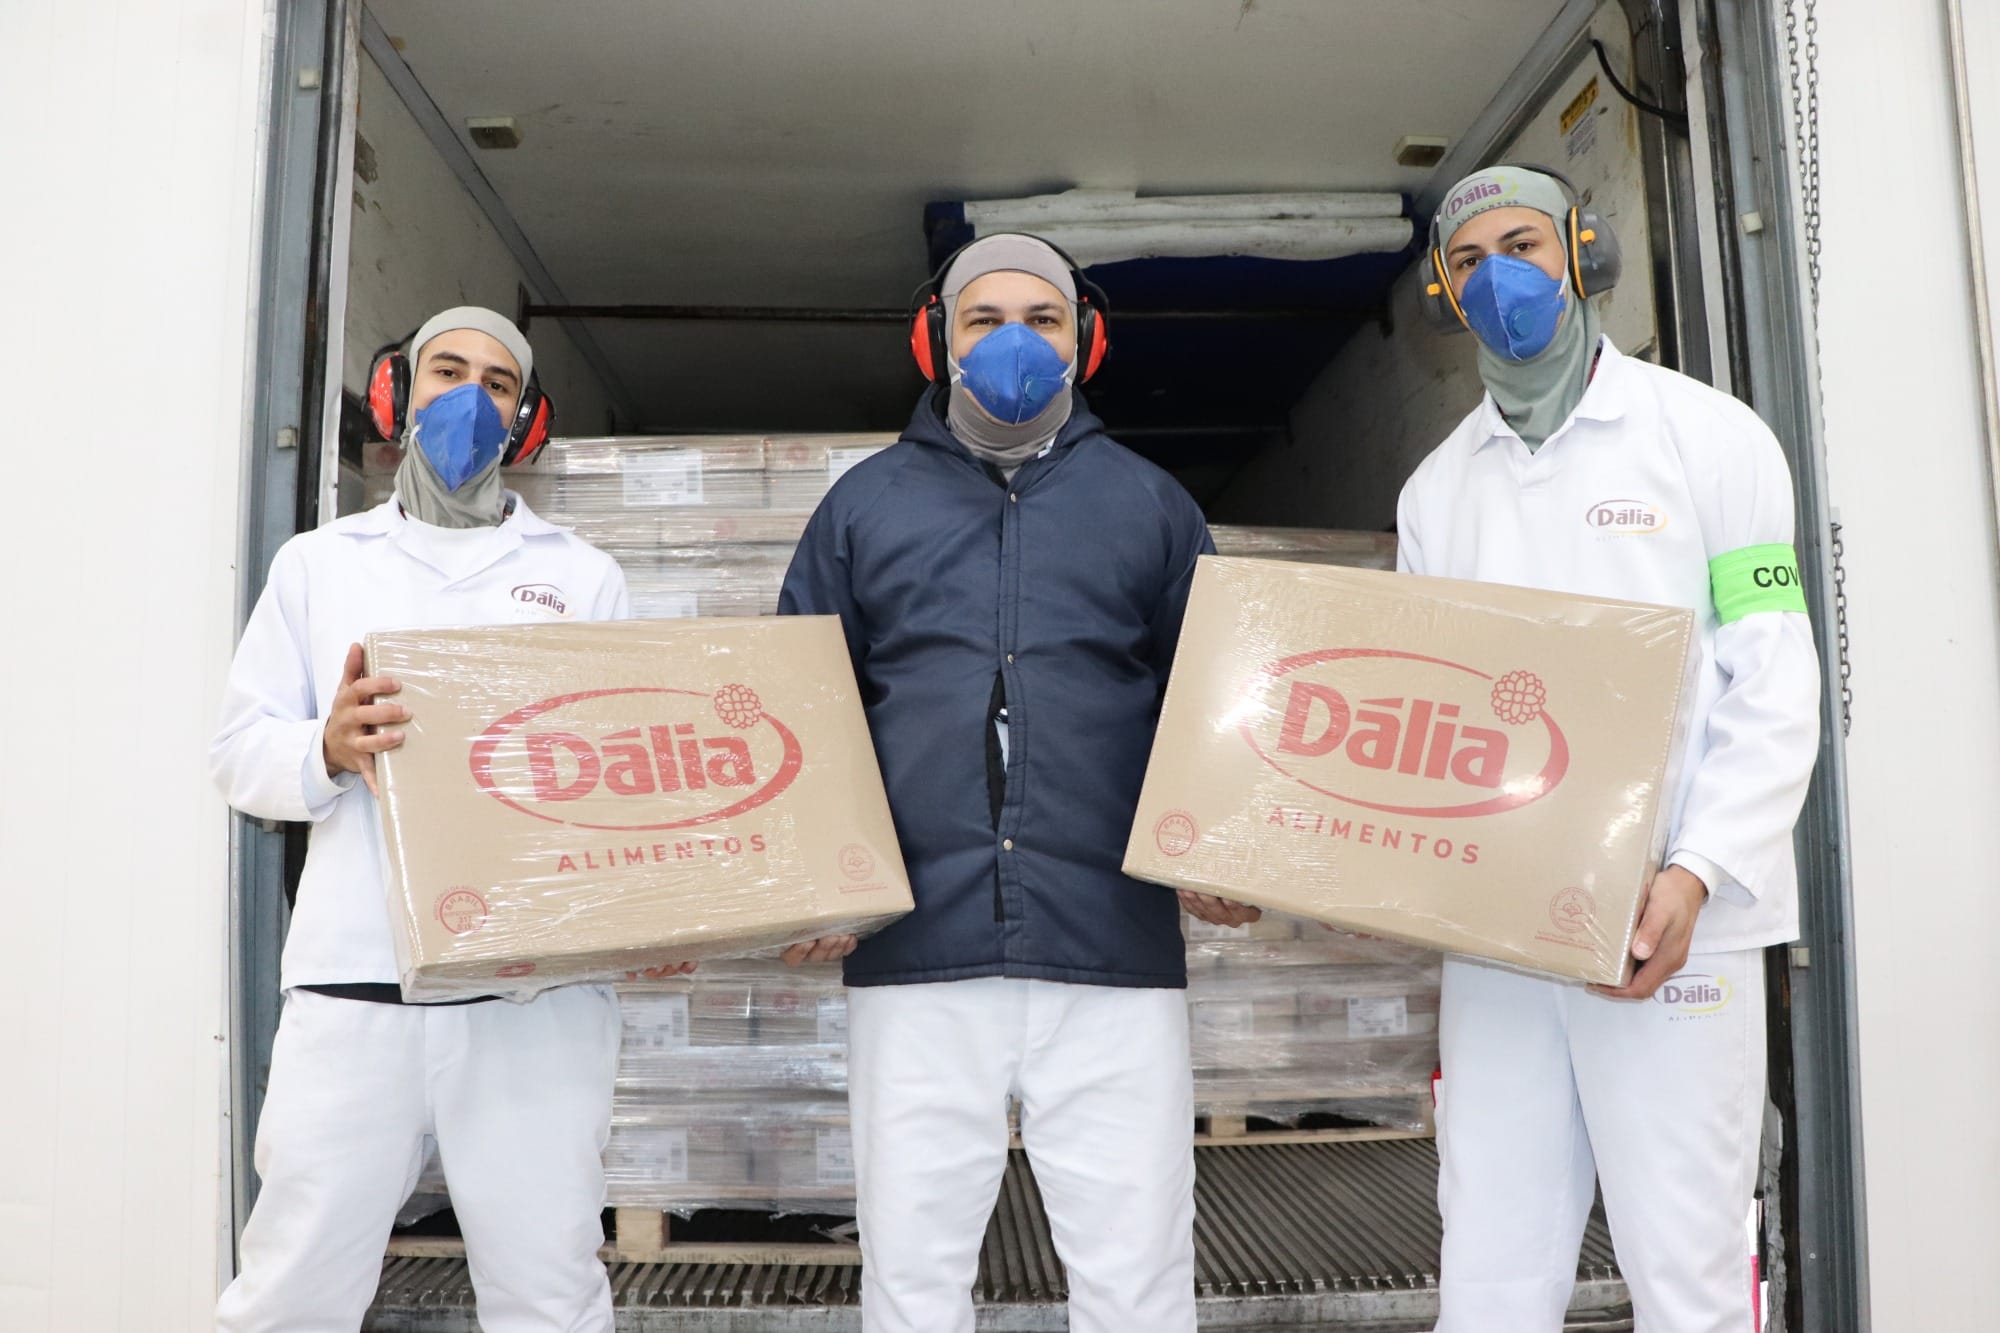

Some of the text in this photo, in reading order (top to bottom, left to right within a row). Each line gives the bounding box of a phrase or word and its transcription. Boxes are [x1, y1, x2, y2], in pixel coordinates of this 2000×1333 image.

[1450, 183, 1502, 216] Dália
[1597, 507, 1656, 527] Dália
[520, 589, 566, 614] Dália
[1276, 680, 1510, 789] Dália
[525, 723, 756, 803] Dália
[557, 834, 767, 873] ALIMENTOS
[1266, 806, 1480, 865] ALIMENTOS
[1663, 984, 1722, 1005] Dália
